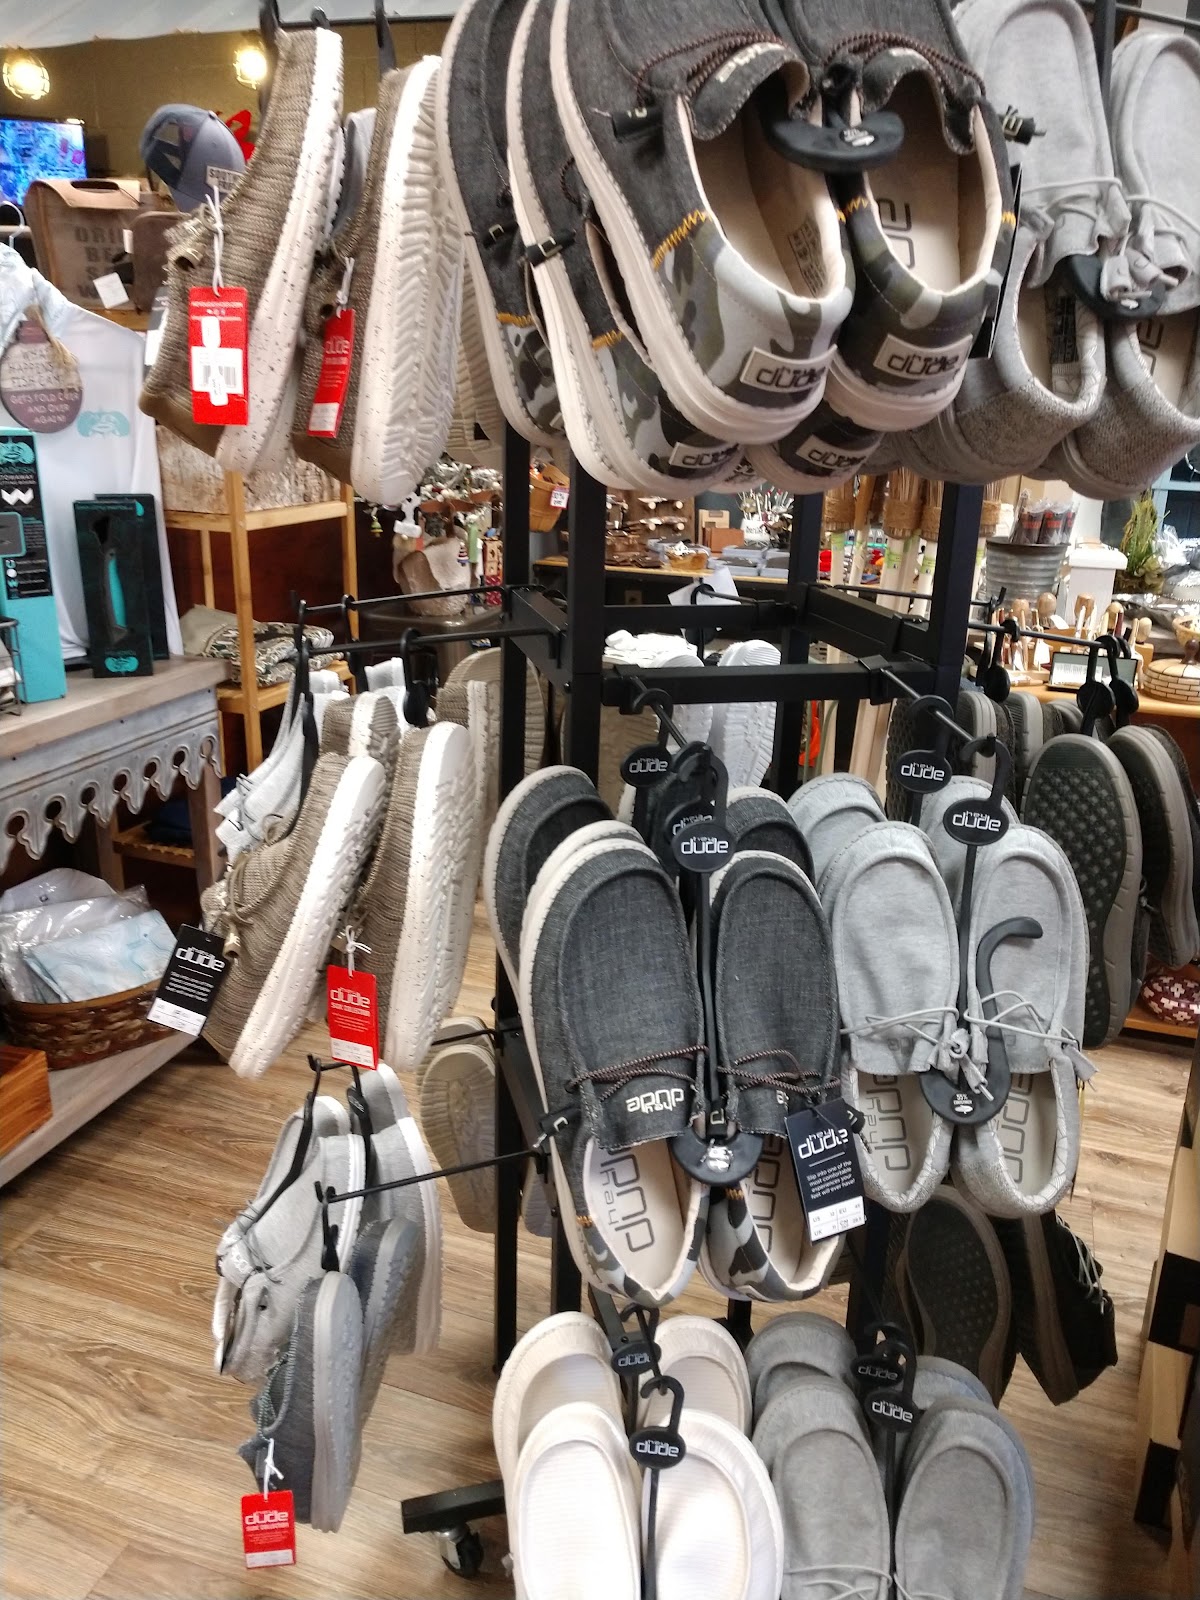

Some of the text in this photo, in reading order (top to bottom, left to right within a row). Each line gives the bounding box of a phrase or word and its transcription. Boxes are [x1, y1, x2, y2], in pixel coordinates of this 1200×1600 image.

[628, 758, 669, 774] dude
[900, 763, 945, 781] dude
[952, 812, 1002, 832] dude
[680, 837, 729, 854] dude
[797, 1128, 850, 1159] dude
[617, 1352, 651, 1367] dud
[857, 1365, 899, 1380] dude
[871, 1400, 914, 1423] dude
[635, 1439, 680, 1457] dude
[244, 1510, 289, 1526] dude
